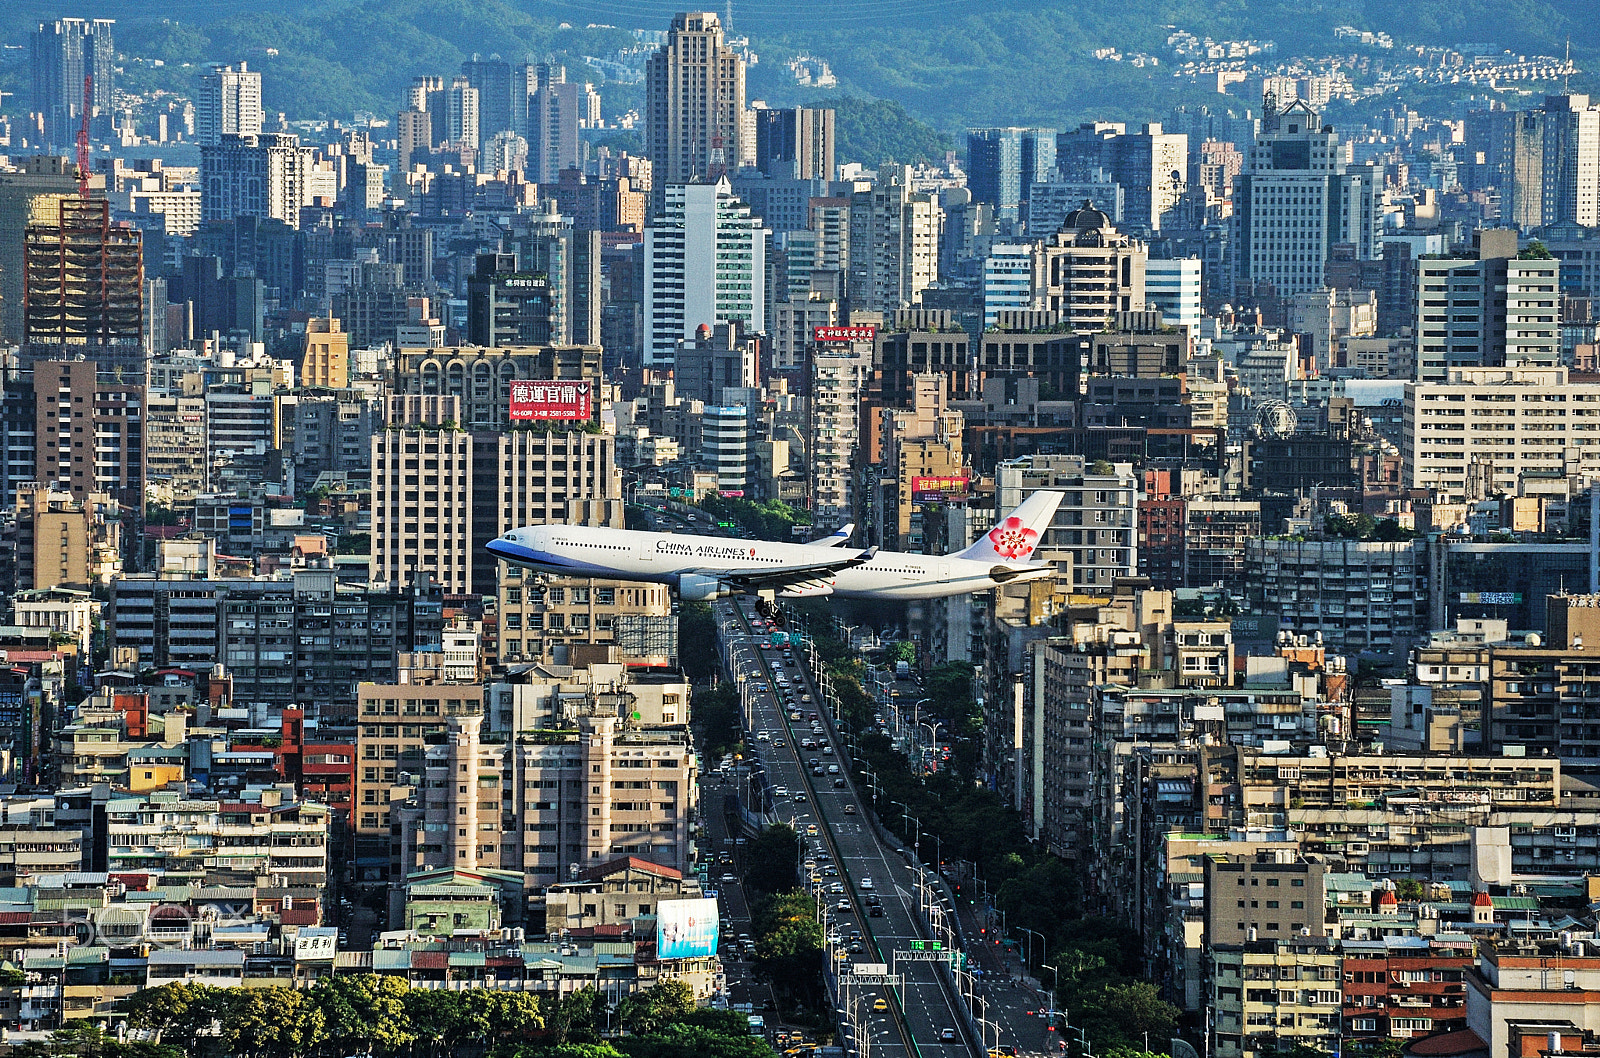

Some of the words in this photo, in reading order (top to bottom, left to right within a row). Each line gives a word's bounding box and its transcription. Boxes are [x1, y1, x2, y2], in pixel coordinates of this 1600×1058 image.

[512, 385, 576, 404] 德運官鼎
[656, 540, 692, 552] CHINA
[696, 546, 746, 556] AIRLINES
